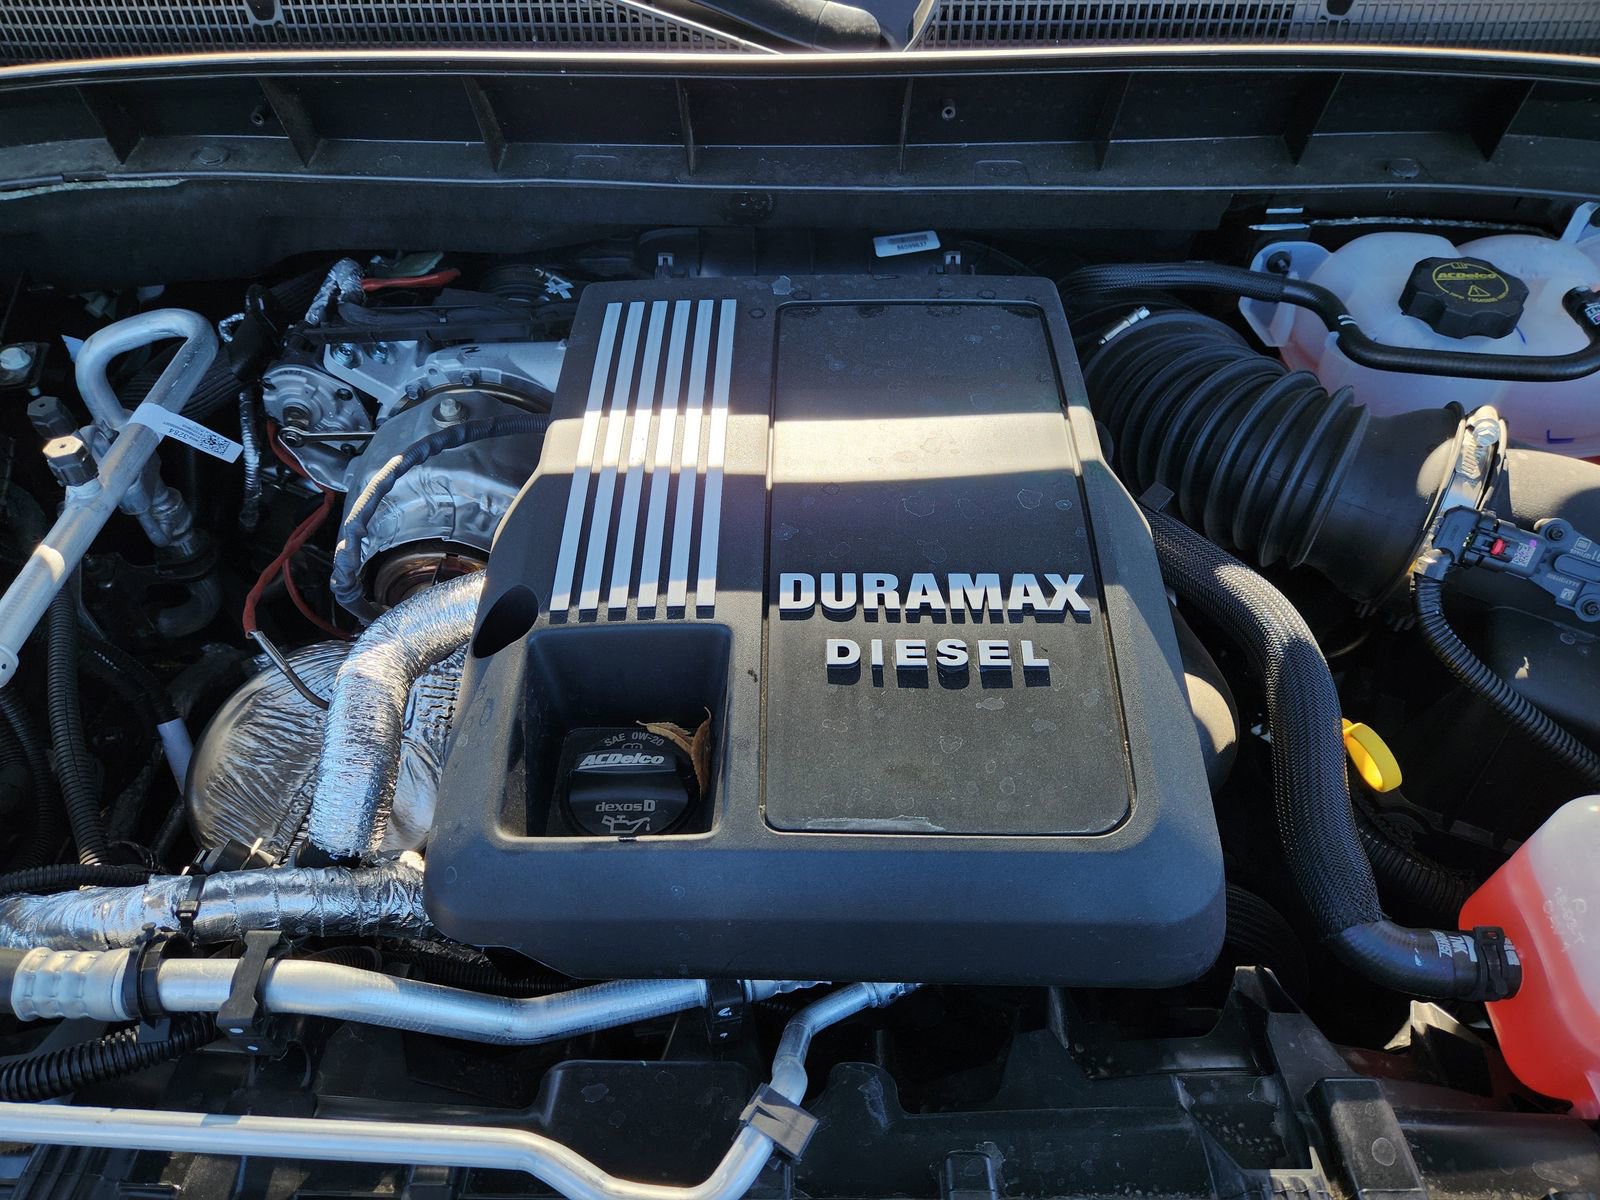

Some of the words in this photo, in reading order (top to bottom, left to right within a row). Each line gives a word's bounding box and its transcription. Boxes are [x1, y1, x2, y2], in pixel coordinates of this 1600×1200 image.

[1436, 272, 1497, 280] ACDelco
[168, 428, 188, 440] 3284
[779, 572, 1091, 614] DURAMAX
[826, 638, 1050, 669] DIESEL
[604, 733, 626, 747] SAE
[631, 731, 665, 747] 0W-20
[577, 752, 665, 768] ACDelco
